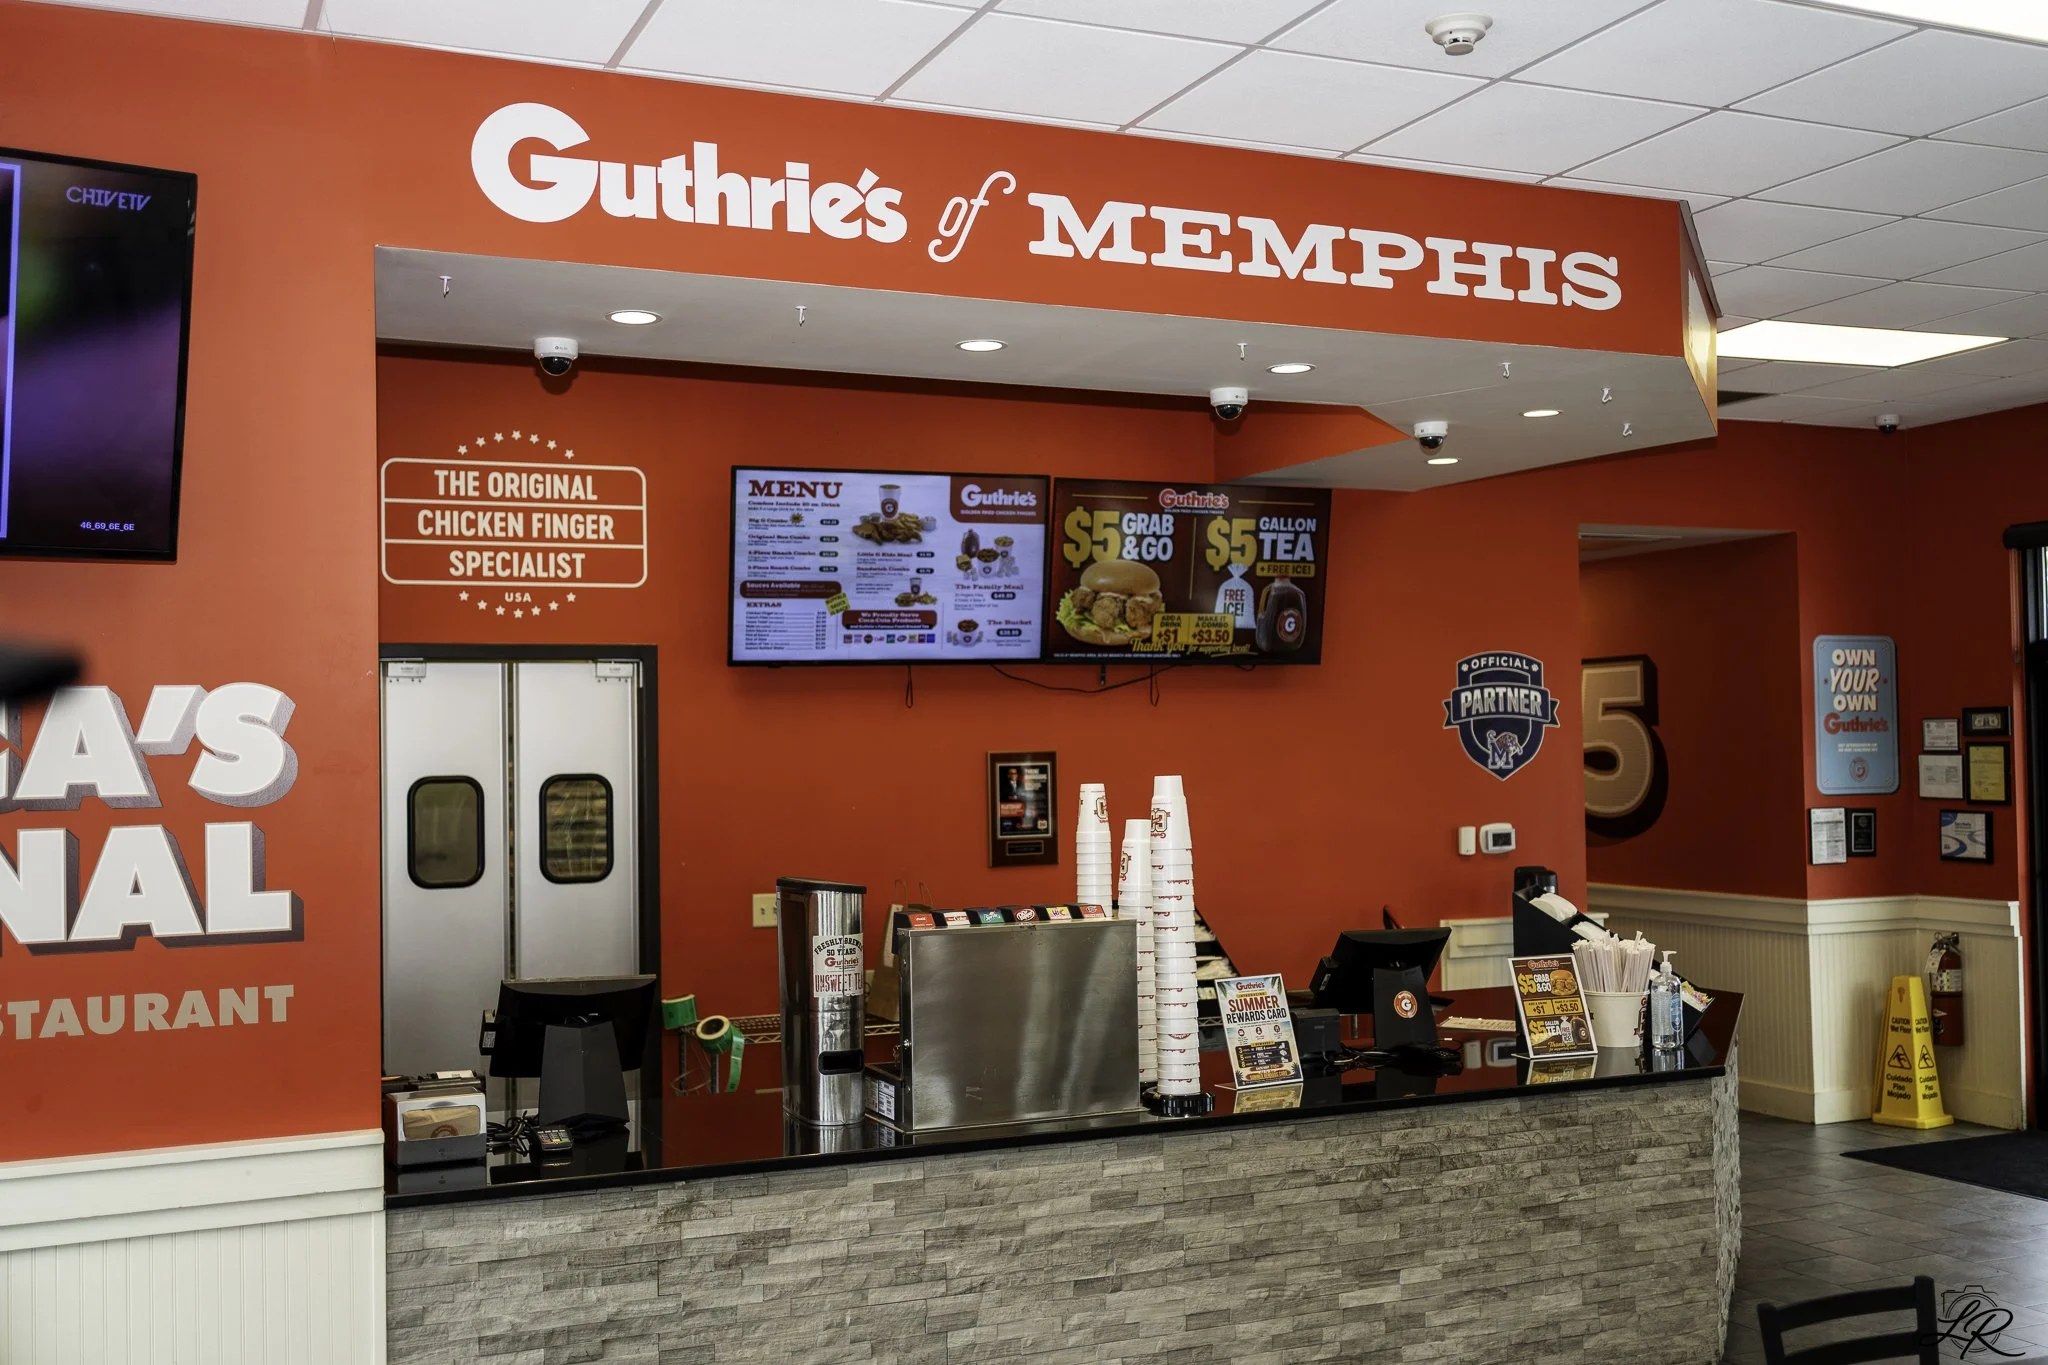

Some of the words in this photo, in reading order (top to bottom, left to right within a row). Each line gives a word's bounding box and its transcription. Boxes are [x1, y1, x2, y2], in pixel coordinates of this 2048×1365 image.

[471, 102, 907, 243] Guthrie's
[928, 171, 1016, 263] of
[1028, 192, 1621, 311] MEMPHIS
[434, 470, 480, 497] THE
[487, 471, 598, 500] ORIGINAL
[748, 480, 843, 499] MENU
[961, 484, 1037, 507] Guthrie's
[1159, 488, 1229, 509] Guthrie's
[418, 509, 524, 538] CHICKEN
[531, 513, 615, 540] FINGER
[1063, 505, 1122, 568] $5
[1122, 512, 1174, 536] GRAB
[1206, 515, 1258, 571] $5
[1259, 517, 1316, 532] GALLON
[1259, 533, 1314, 561] TEA
[449, 550, 585, 578] SPECIALIST
[1267, 564, 1290, 575] FREE
[1292, 565, 1311, 575] ICE!
[504, 592, 532, 603] USA
[1224, 589, 1245, 601] FREE
[1223, 602, 1244, 616] ICE!
[1192, 630, 1229, 642] +$3.50
[1471, 657, 1529, 670] OFFICIAL
[1831, 649, 1876, 667] OWN
[1829, 668, 1880, 693] YOUR
[1461, 687, 1542, 717] PARTNER
[1833, 695, 1878, 712] OWN
[1823, 712, 1889, 735] Guthrie's
[814, 937, 843, 955] FRESHLY
[837, 948, 856, 956] YEARS
[815, 973, 851, 992] UNSWEET
[1236, 982, 1265, 991] Guthrie's
[1518, 973, 1537, 995] $5
[1533, 974, 1550, 983] GRAB
[1228, 995, 1280, 1012] SUMMER
[1533, 1005, 1545, 1014] +$1
[1556, 1003, 1579, 1013] +$3.50
[1226, 1010, 1266, 1024] REWARDS
[1267, 1008, 1287, 1019] CARD
[1892, 1016, 1910, 1026] CAUTION
[1529, 1020, 1546, 1035] $5
[1546, 1026, 1562, 1036] TEA
[1886, 1073, 1913, 1083] Cuidado
[1919, 1074, 1937, 1084] Cuidado
[1887, 1090, 1911, 1100] Mojado
[1892, 1083, 1905, 1092] Piso
[1922, 1090, 1938, 1100] Mojado
[1925, 1083, 1933, 1091] Piso
